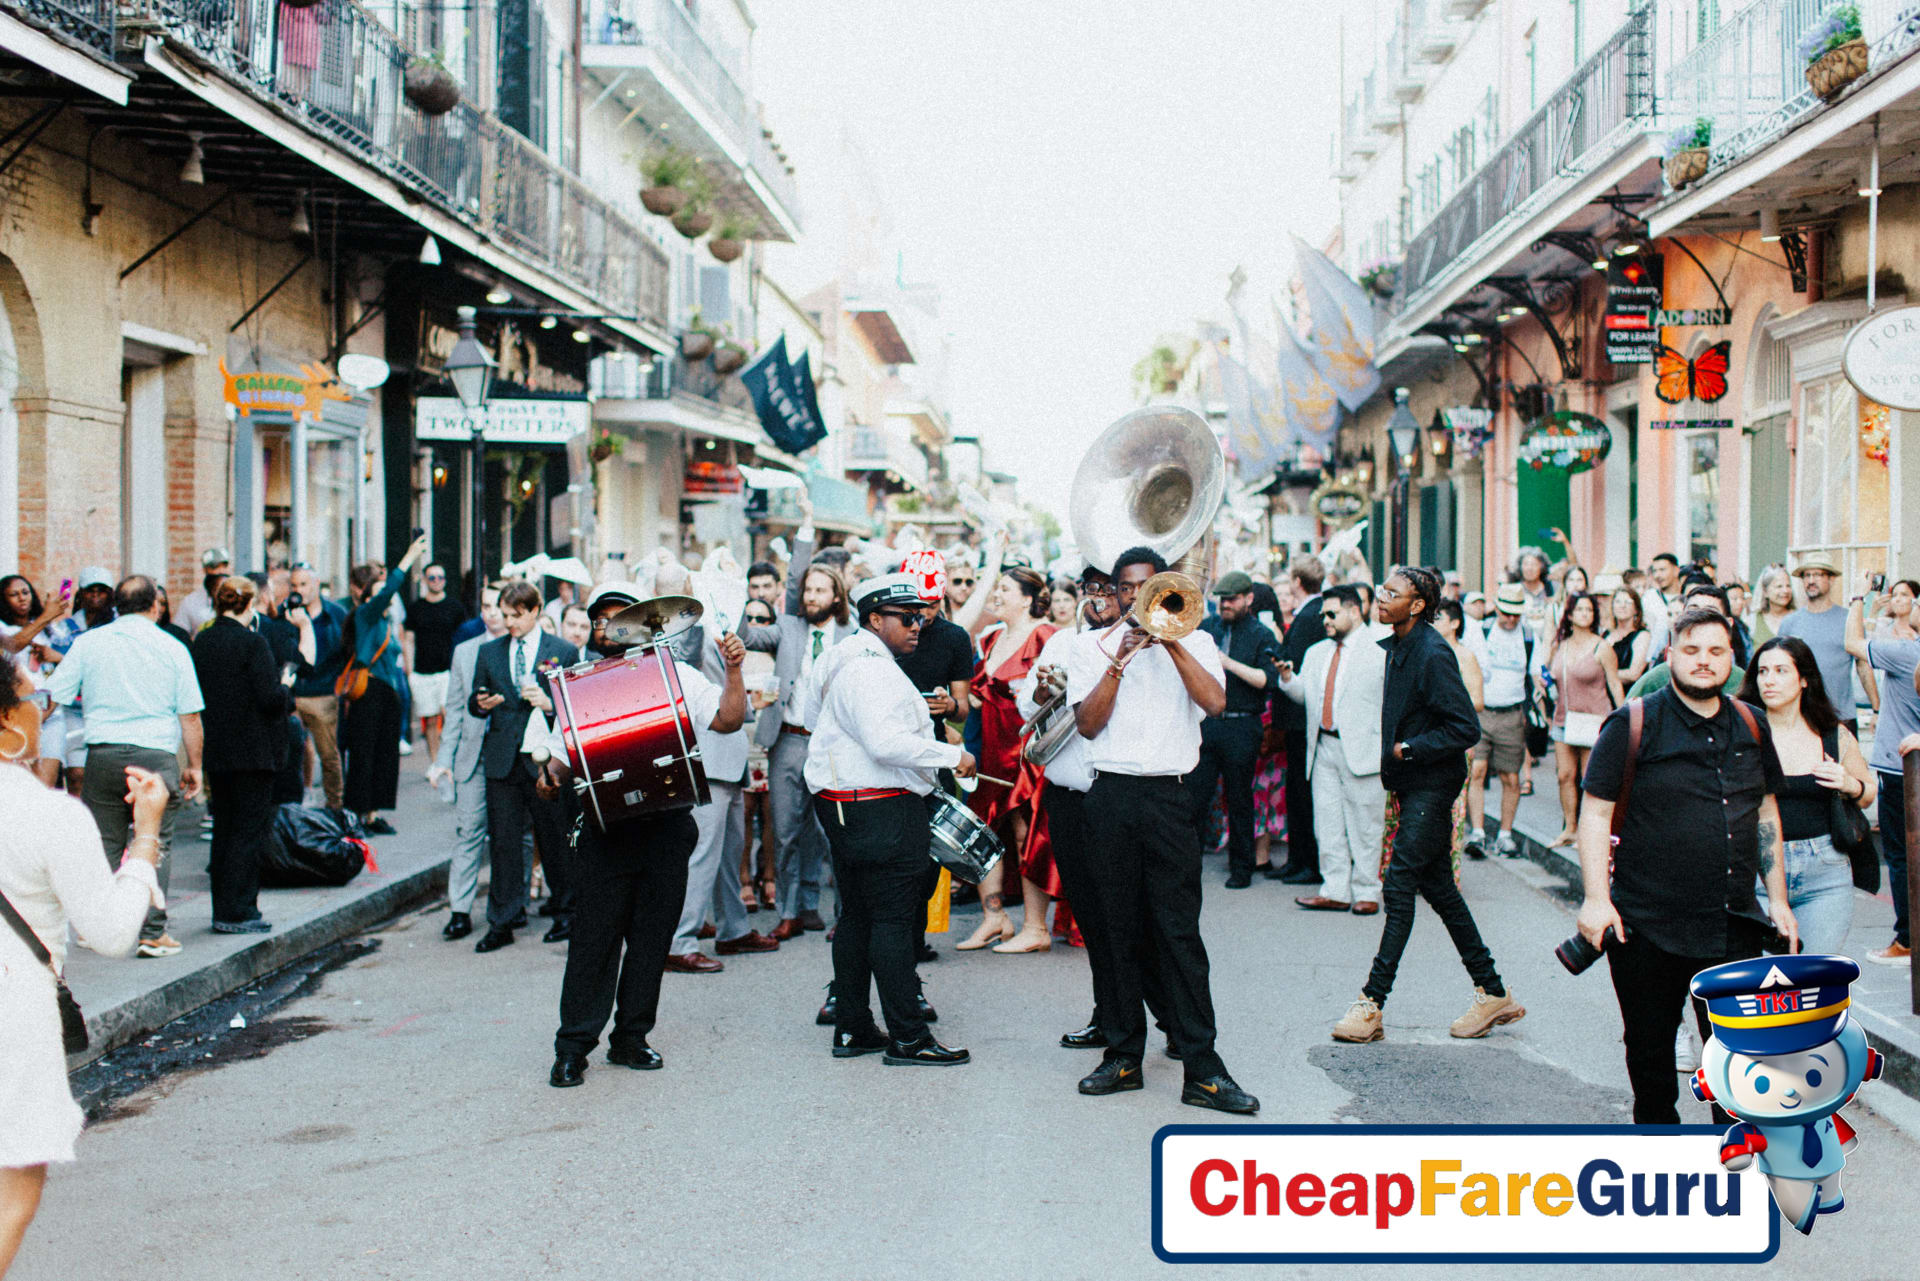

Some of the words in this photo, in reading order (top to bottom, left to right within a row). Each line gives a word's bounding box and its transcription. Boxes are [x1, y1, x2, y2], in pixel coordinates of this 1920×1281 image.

[1655, 309, 1724, 327] ADORN
[1609, 331, 1629, 342] FOR
[426, 415, 475, 430] TWO
[484, 417, 577, 433] SISTERS
